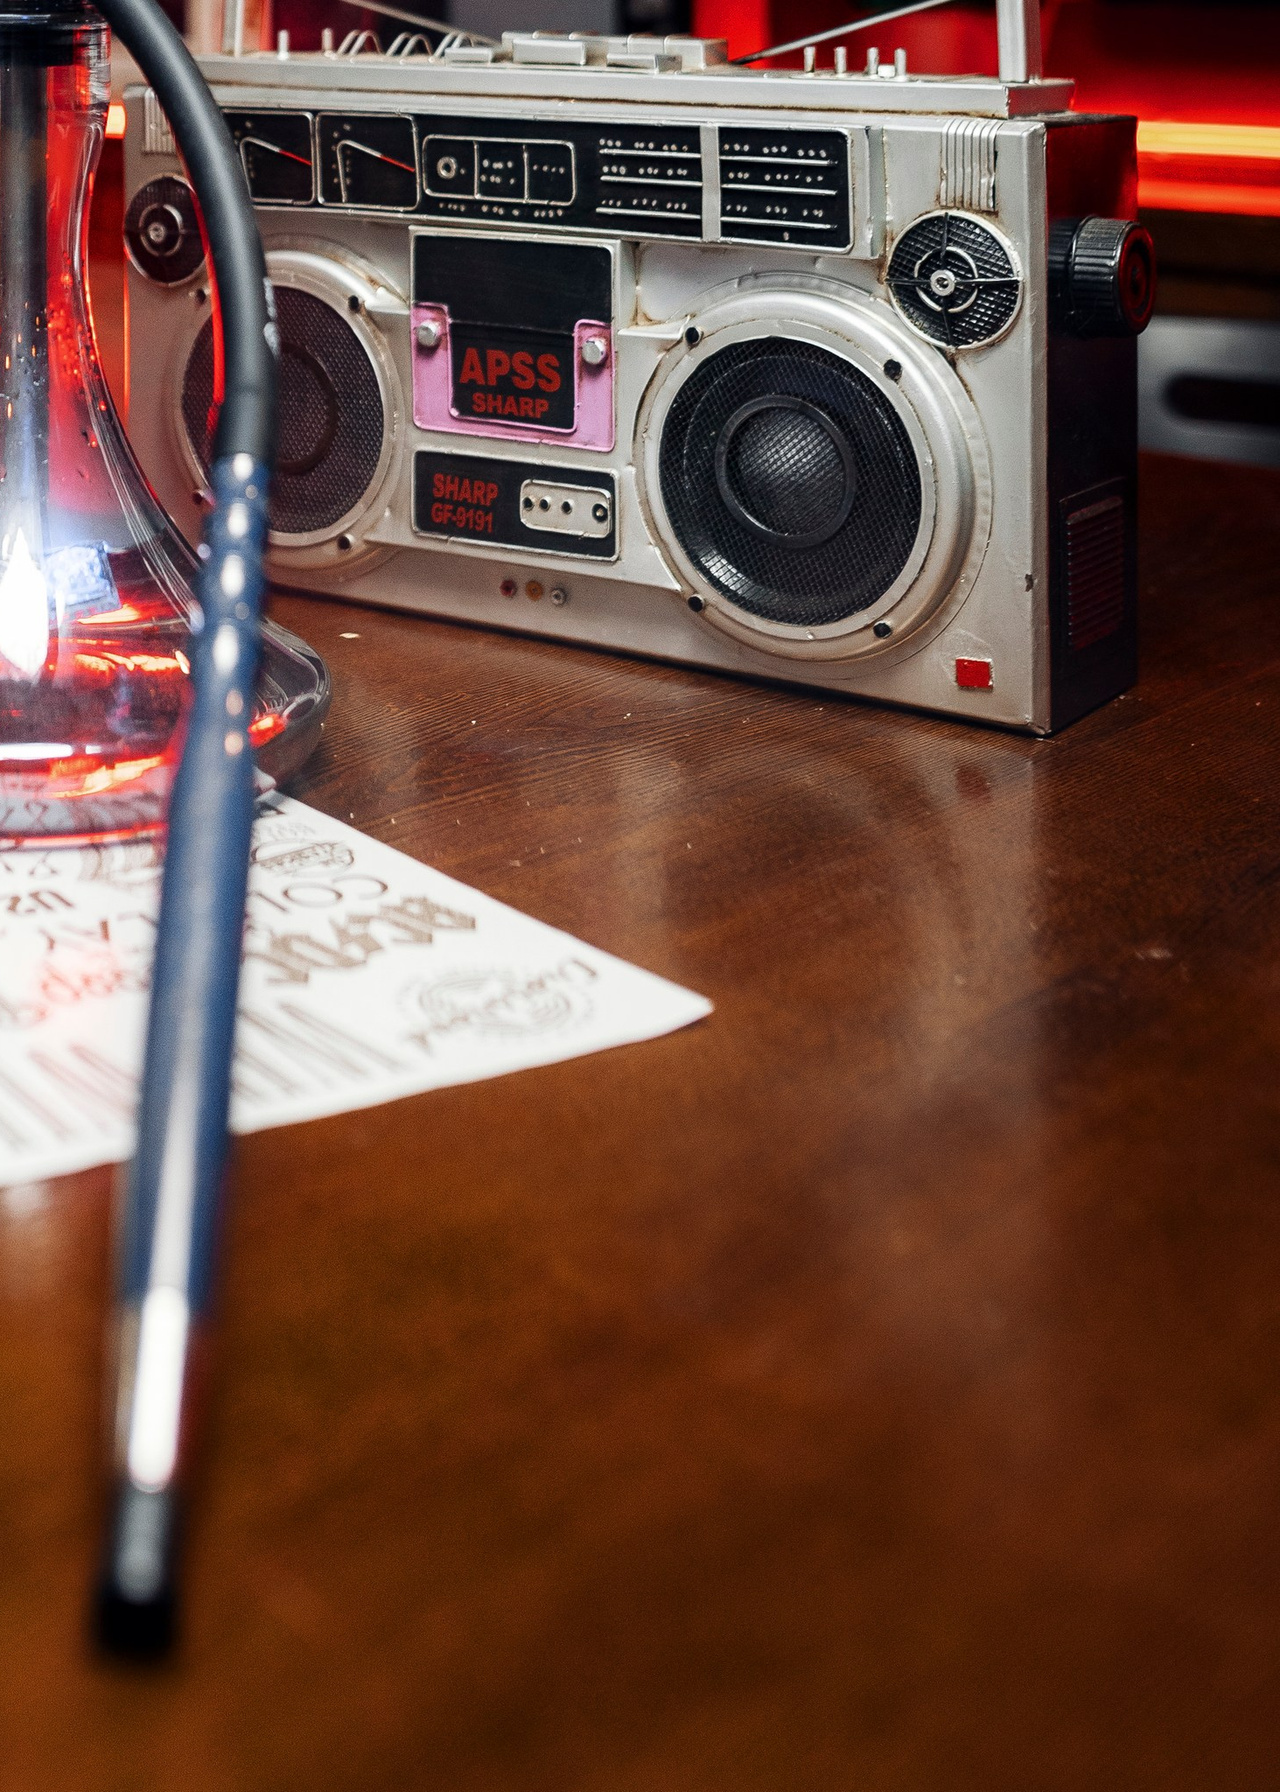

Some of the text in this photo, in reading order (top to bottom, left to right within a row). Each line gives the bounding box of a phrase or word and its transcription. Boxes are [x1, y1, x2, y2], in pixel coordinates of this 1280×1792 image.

[459, 347, 562, 393] APSS
[471, 392, 549, 419] SHARP
[432, 472, 499, 507] SHARP
[430, 501, 494, 534] GF-9191
